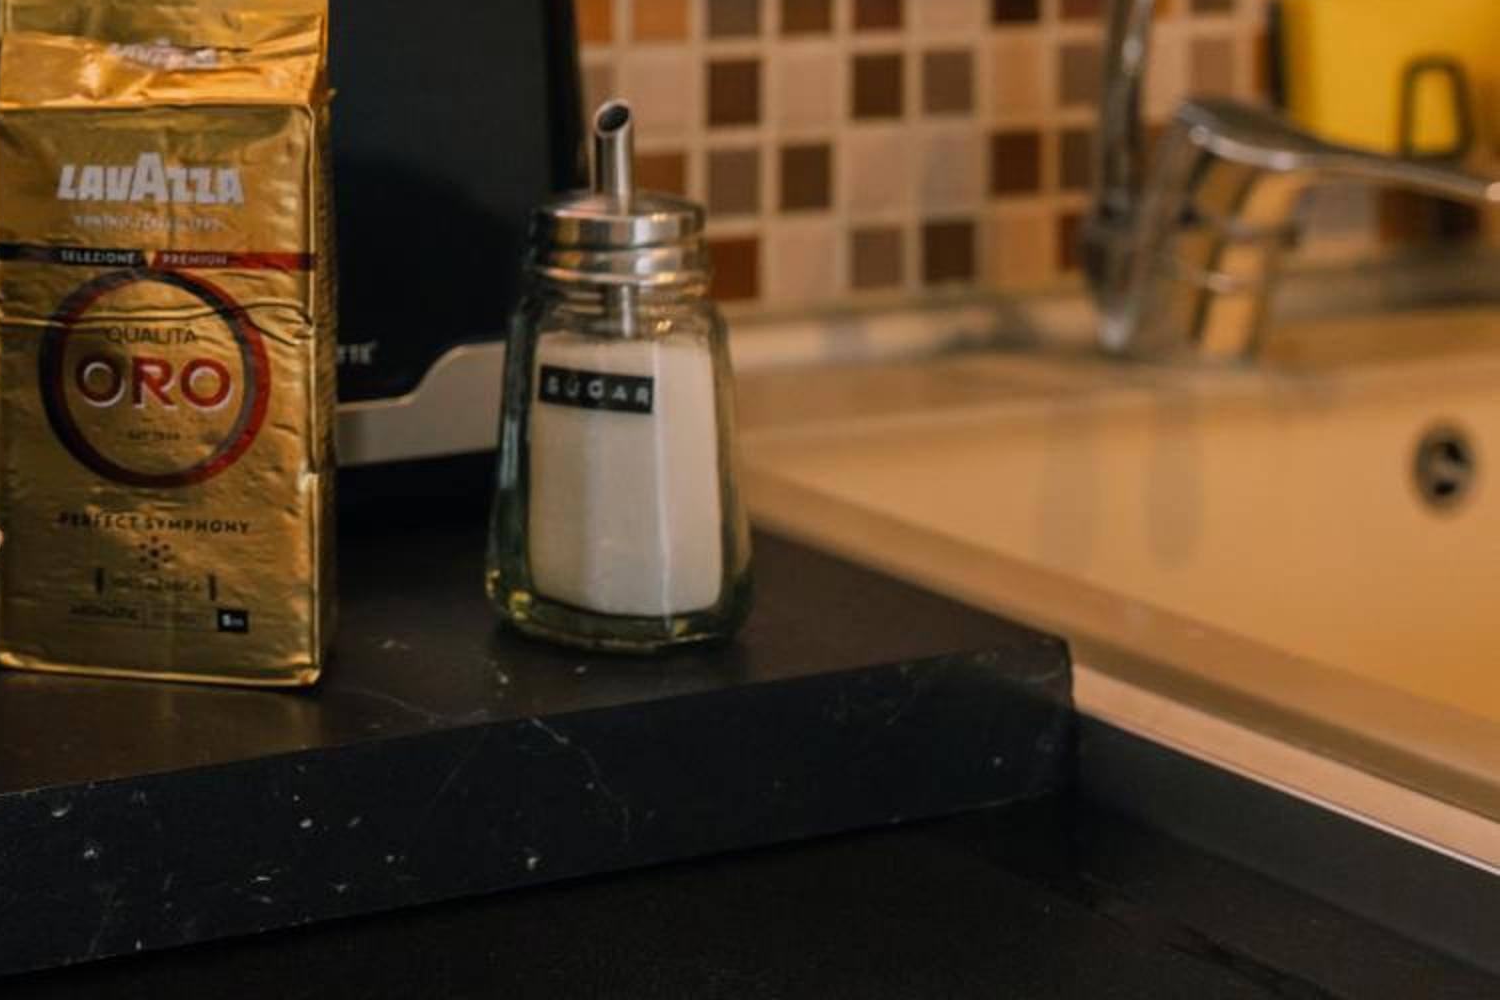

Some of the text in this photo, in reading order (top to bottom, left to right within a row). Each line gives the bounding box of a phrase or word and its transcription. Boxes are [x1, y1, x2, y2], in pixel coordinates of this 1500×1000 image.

[57, 151, 245, 205] LAVAZZA
[61, 250, 229, 267] SELEZIONE PREMIUM
[74, 355, 235, 411] ORO
[544, 375, 652, 405] SUGAR
[53, 510, 251, 535] PERFECT SYMPHONY
